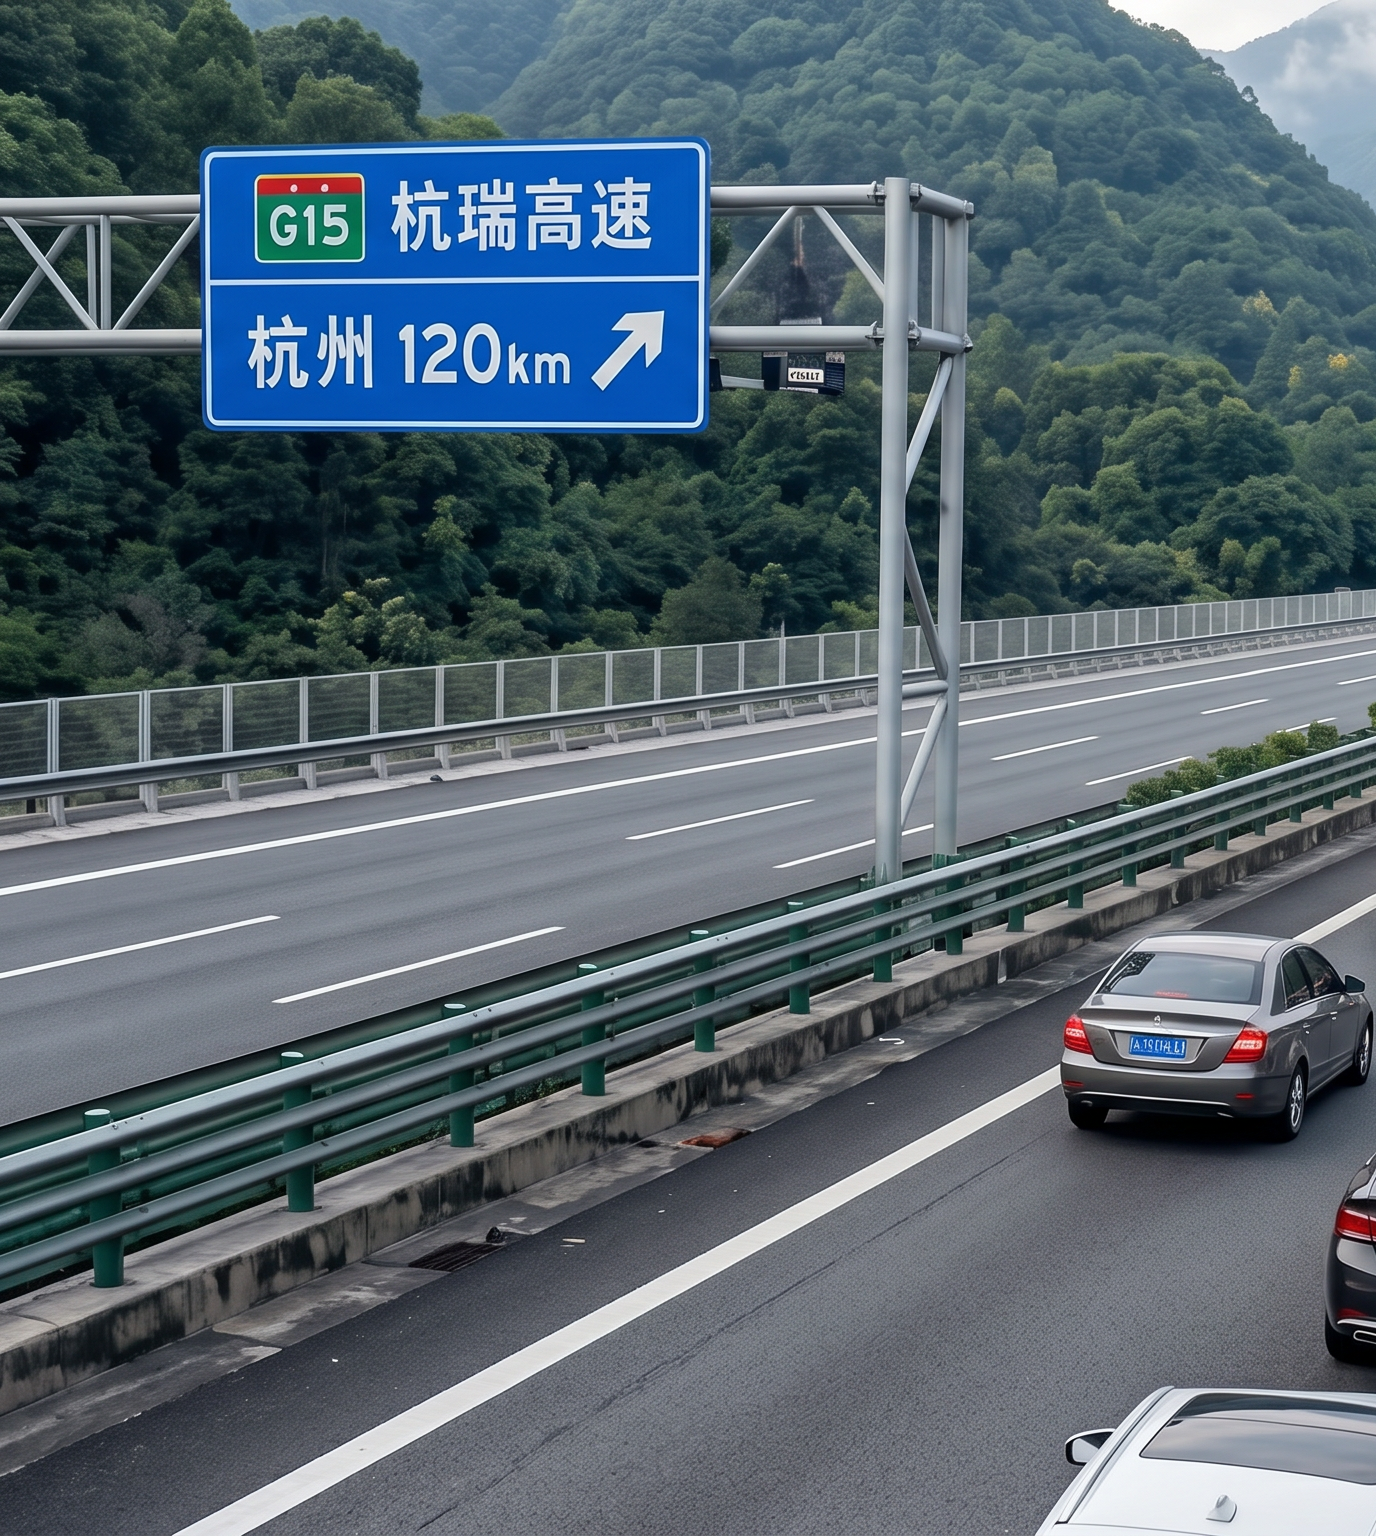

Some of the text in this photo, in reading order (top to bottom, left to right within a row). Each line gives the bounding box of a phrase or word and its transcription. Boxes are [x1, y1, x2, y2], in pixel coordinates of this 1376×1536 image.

[269, 204, 349, 247] G15
[391, 176, 652, 253] 杭瑞高速
[247, 314, 571, 389] 杭州 120km
